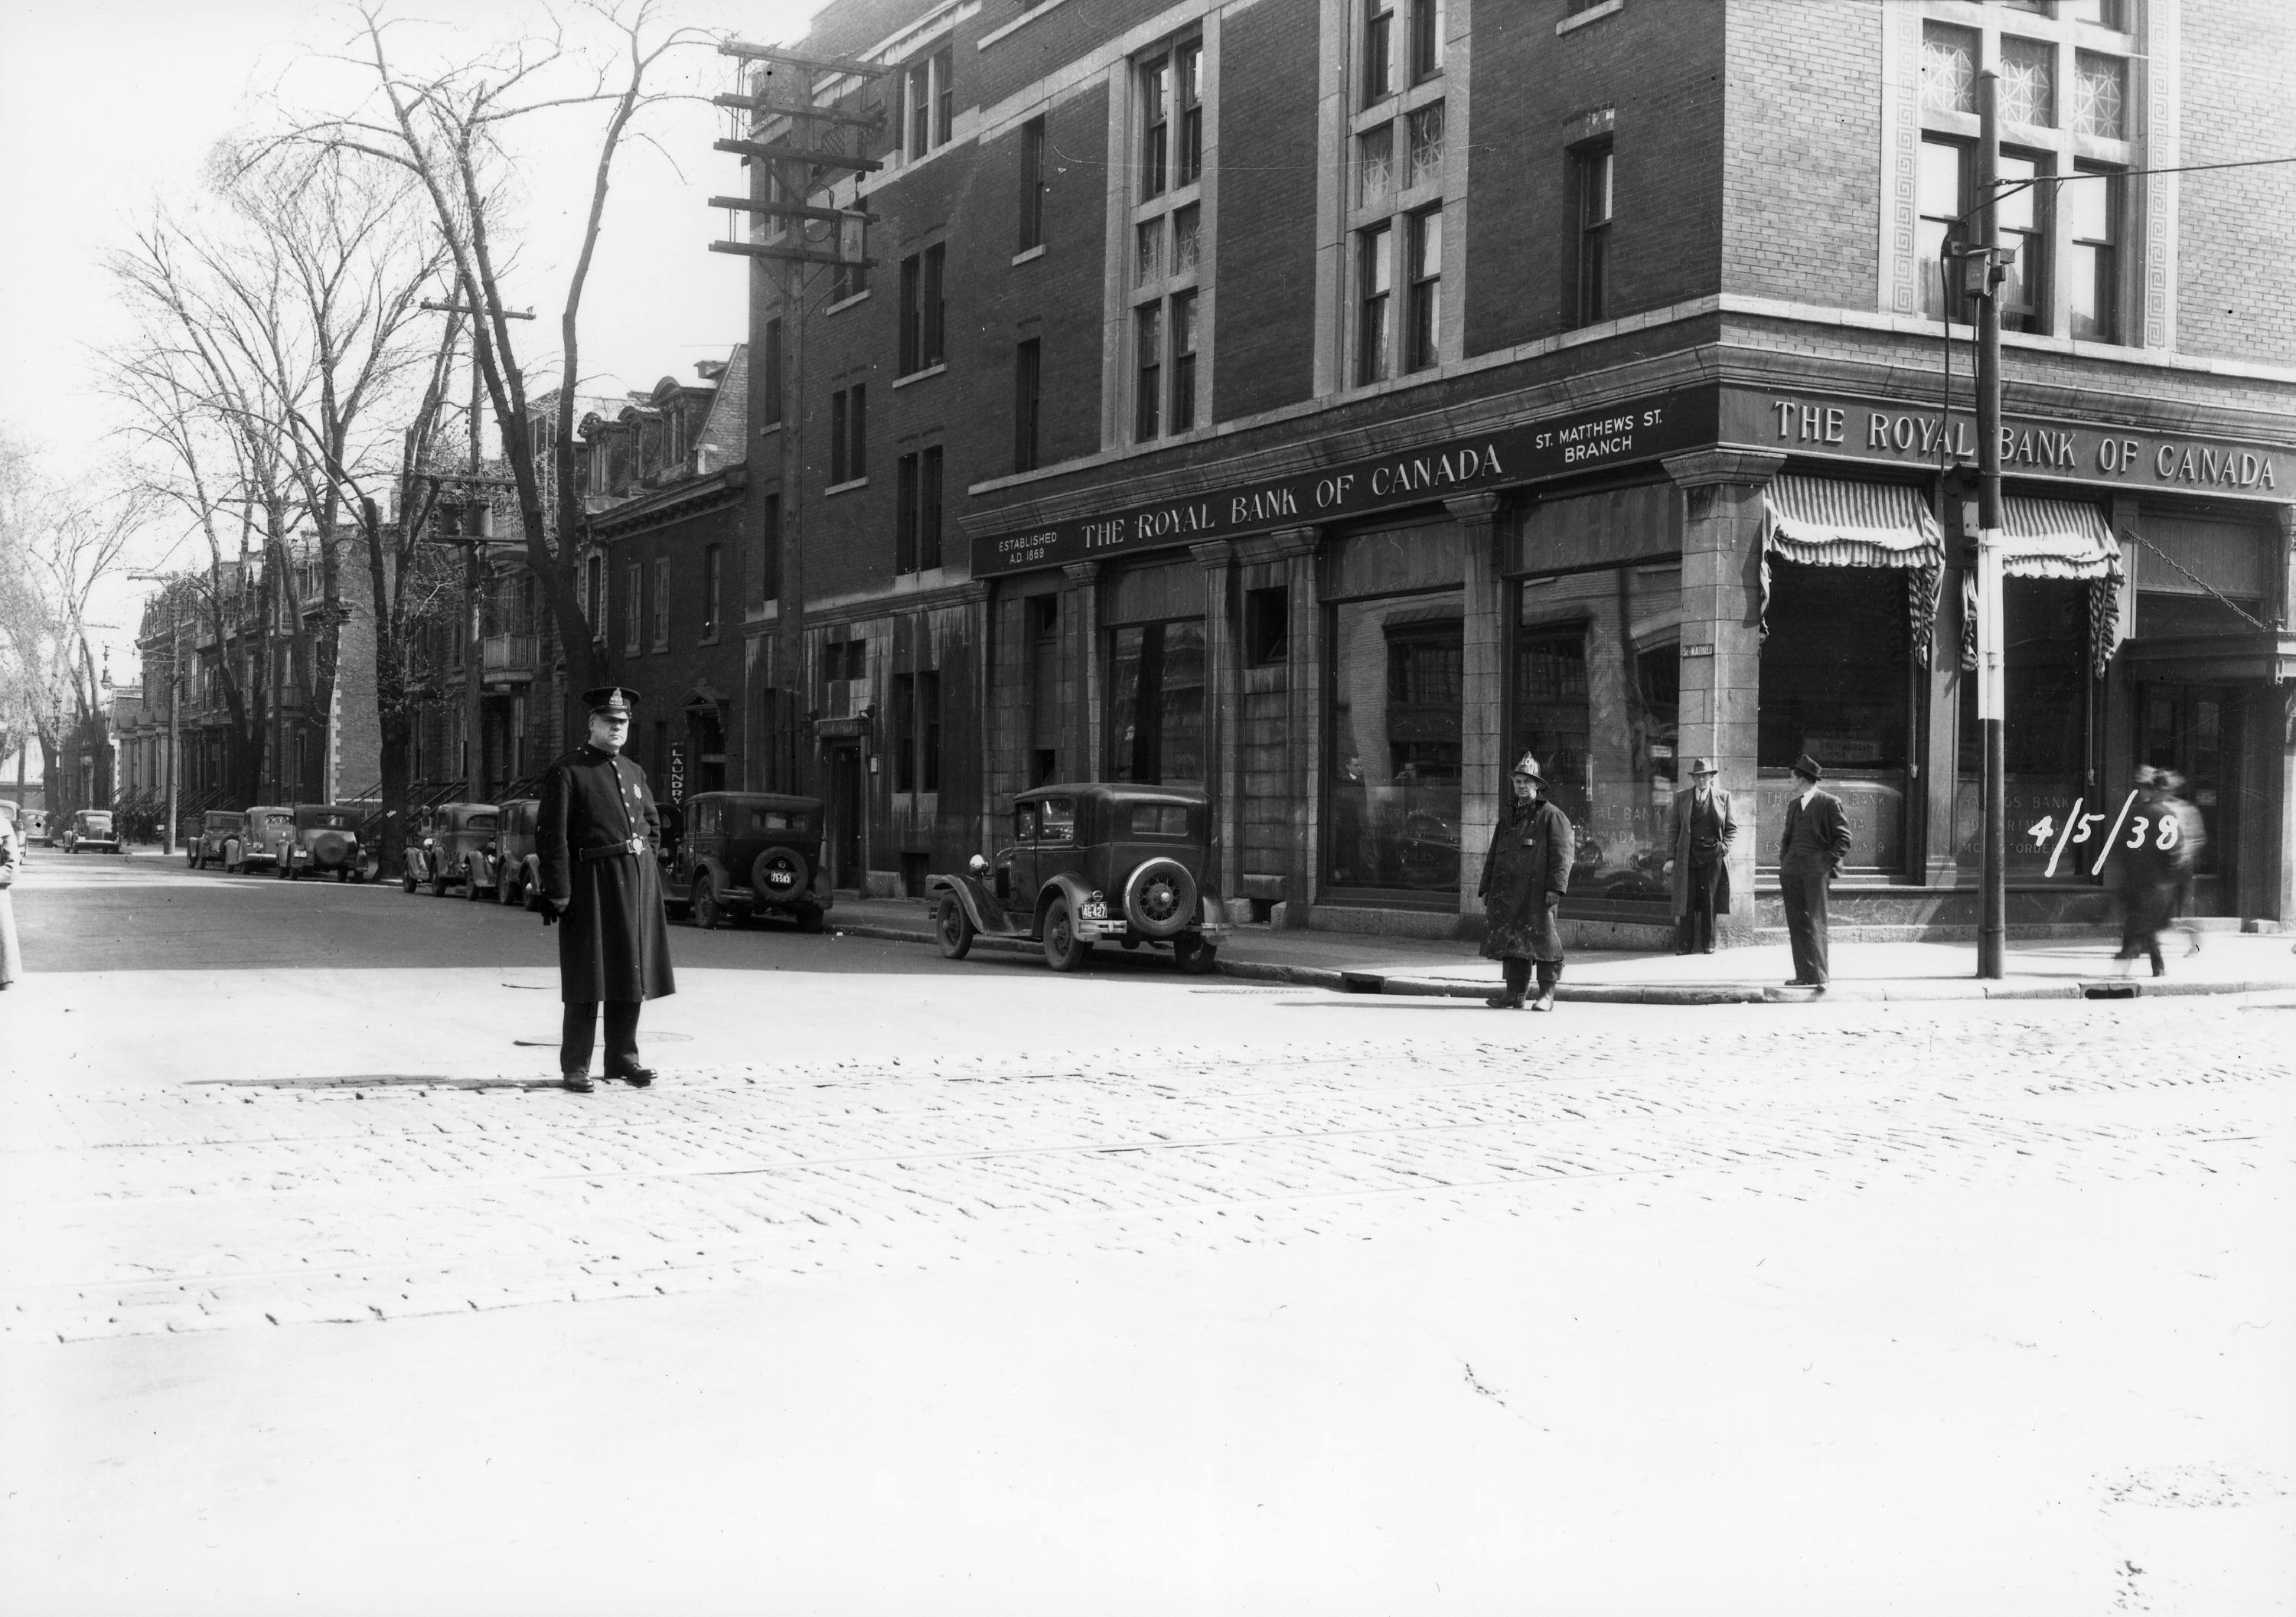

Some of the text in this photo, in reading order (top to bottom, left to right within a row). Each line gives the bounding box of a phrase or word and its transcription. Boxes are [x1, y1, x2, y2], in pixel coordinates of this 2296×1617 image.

[1535, 409, 1662, 449] ST. MATTHEWS ST.
[1564, 435, 1632, 463] BRANCH
[1775, 400, 2275, 488] THE ROYAL BANK OF CANADA
[1081, 443, 1502, 549] THE ROYAL BANK OF CANADA
[999, 532, 1057, 552] ESTABLISHED
[1026, 547, 1045, 561] 1869
[671, 749, 684, 804] LAUNDRY
[1851, 793, 1886, 806] BANK
[1963, 795, 2069, 809] SAGS BANK
